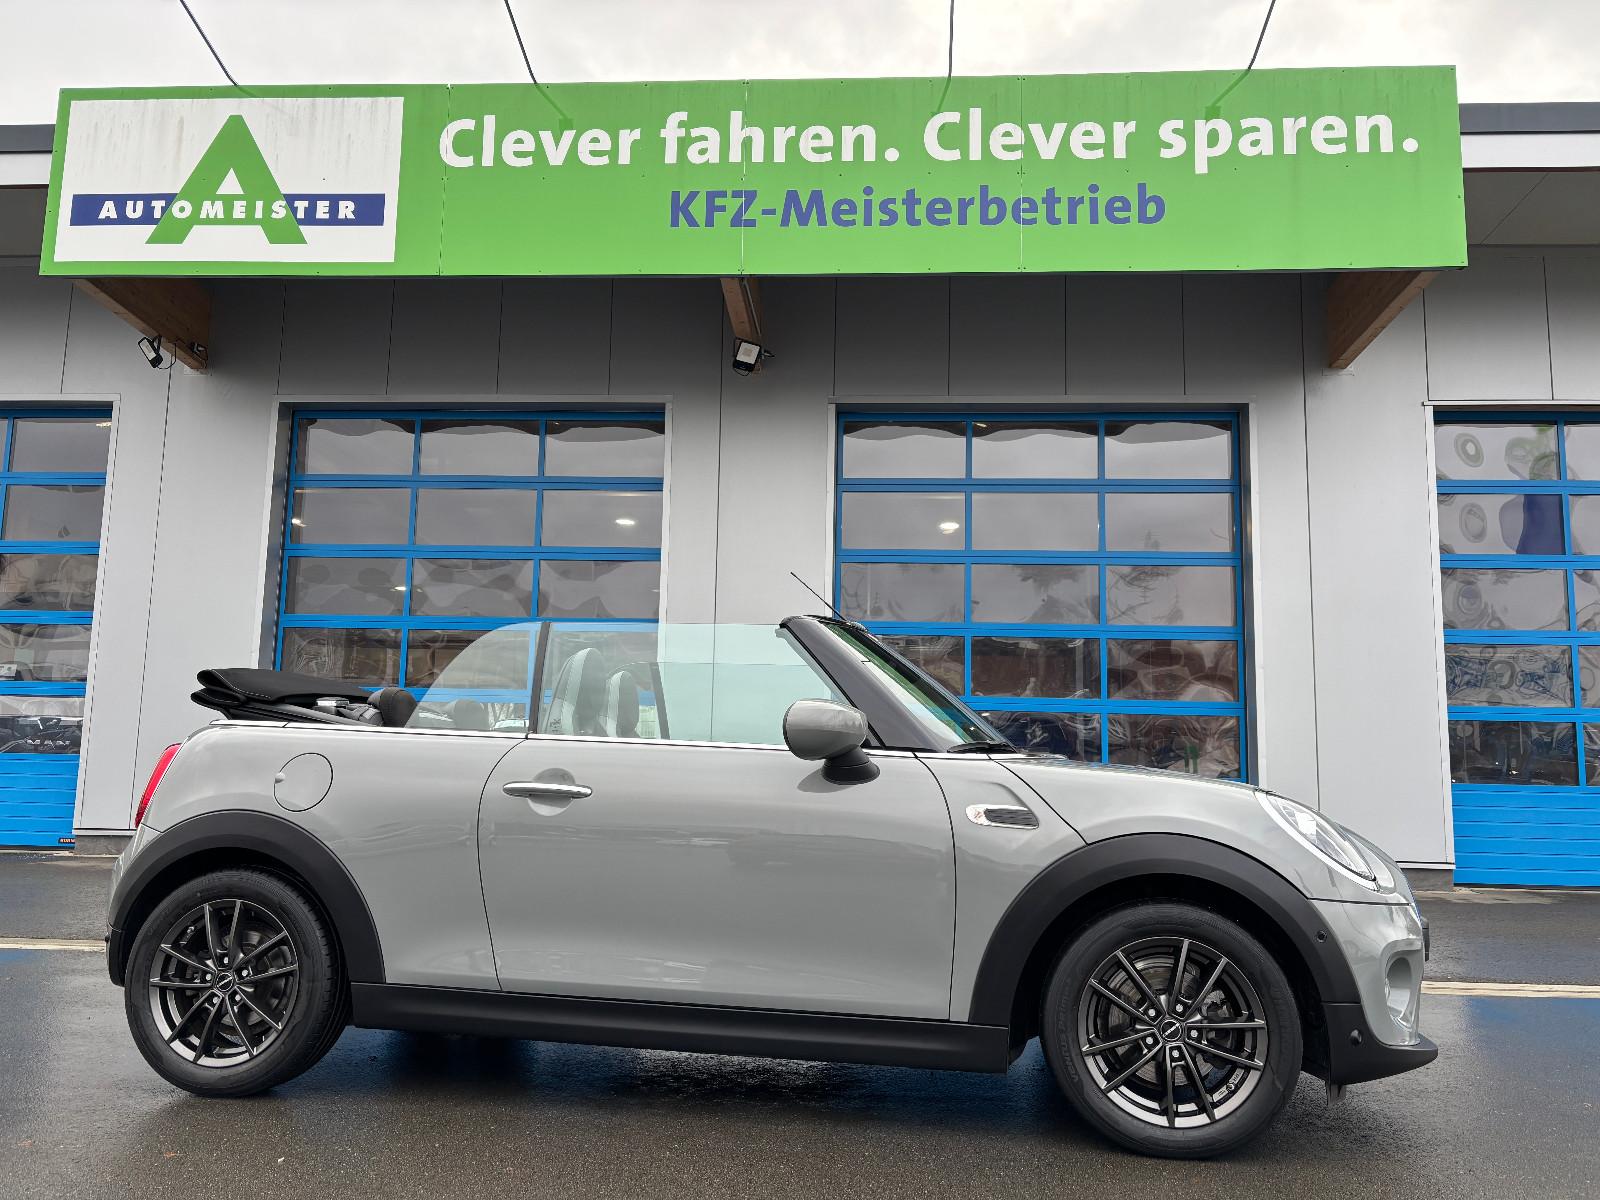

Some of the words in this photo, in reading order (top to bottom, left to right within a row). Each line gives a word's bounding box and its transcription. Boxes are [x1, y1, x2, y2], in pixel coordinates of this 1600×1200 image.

[438, 114, 642, 168] Clever
[661, 110, 900, 165] fahren.
[923, 107, 1137, 162] Clever
[1158, 113, 1419, 175] sparen.
[97, 199, 357, 220] AUTOMEISTER
[669, 183, 1166, 228] KFZ-Meisterbetrieb
